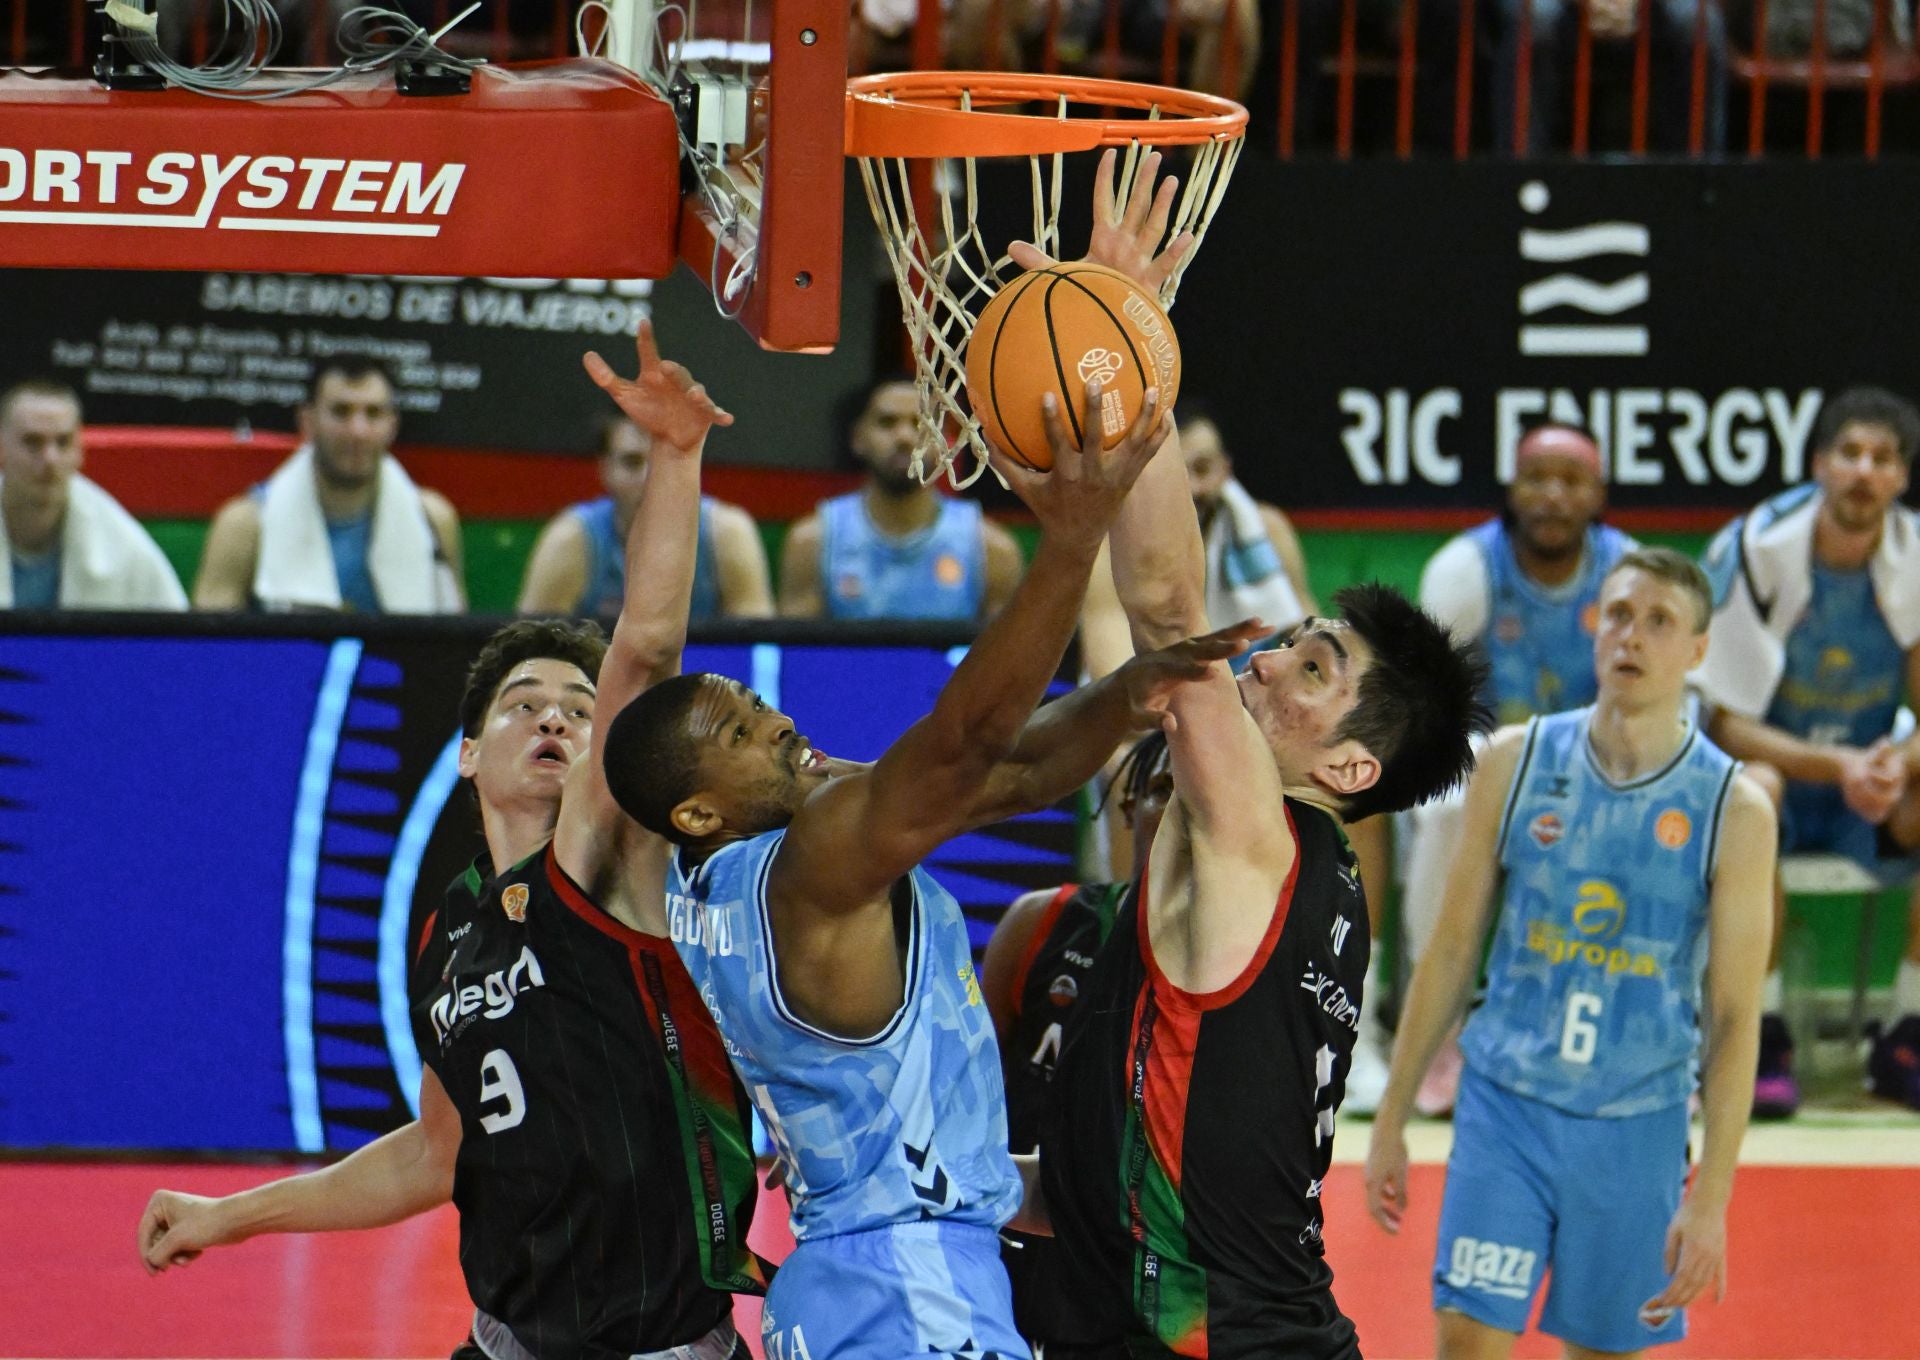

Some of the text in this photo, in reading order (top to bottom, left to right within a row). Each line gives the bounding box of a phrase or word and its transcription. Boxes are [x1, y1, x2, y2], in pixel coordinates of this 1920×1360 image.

[138, 153, 466, 228] SYSTEM
[399, 284, 455, 324] DE
[1338, 387, 1462, 485] RIC
[1529, 926, 1662, 978] agropa
[1560, 991, 1602, 1065] 6
[480, 1048, 526, 1135] 9
[710, 1202, 725, 1243] 39300
